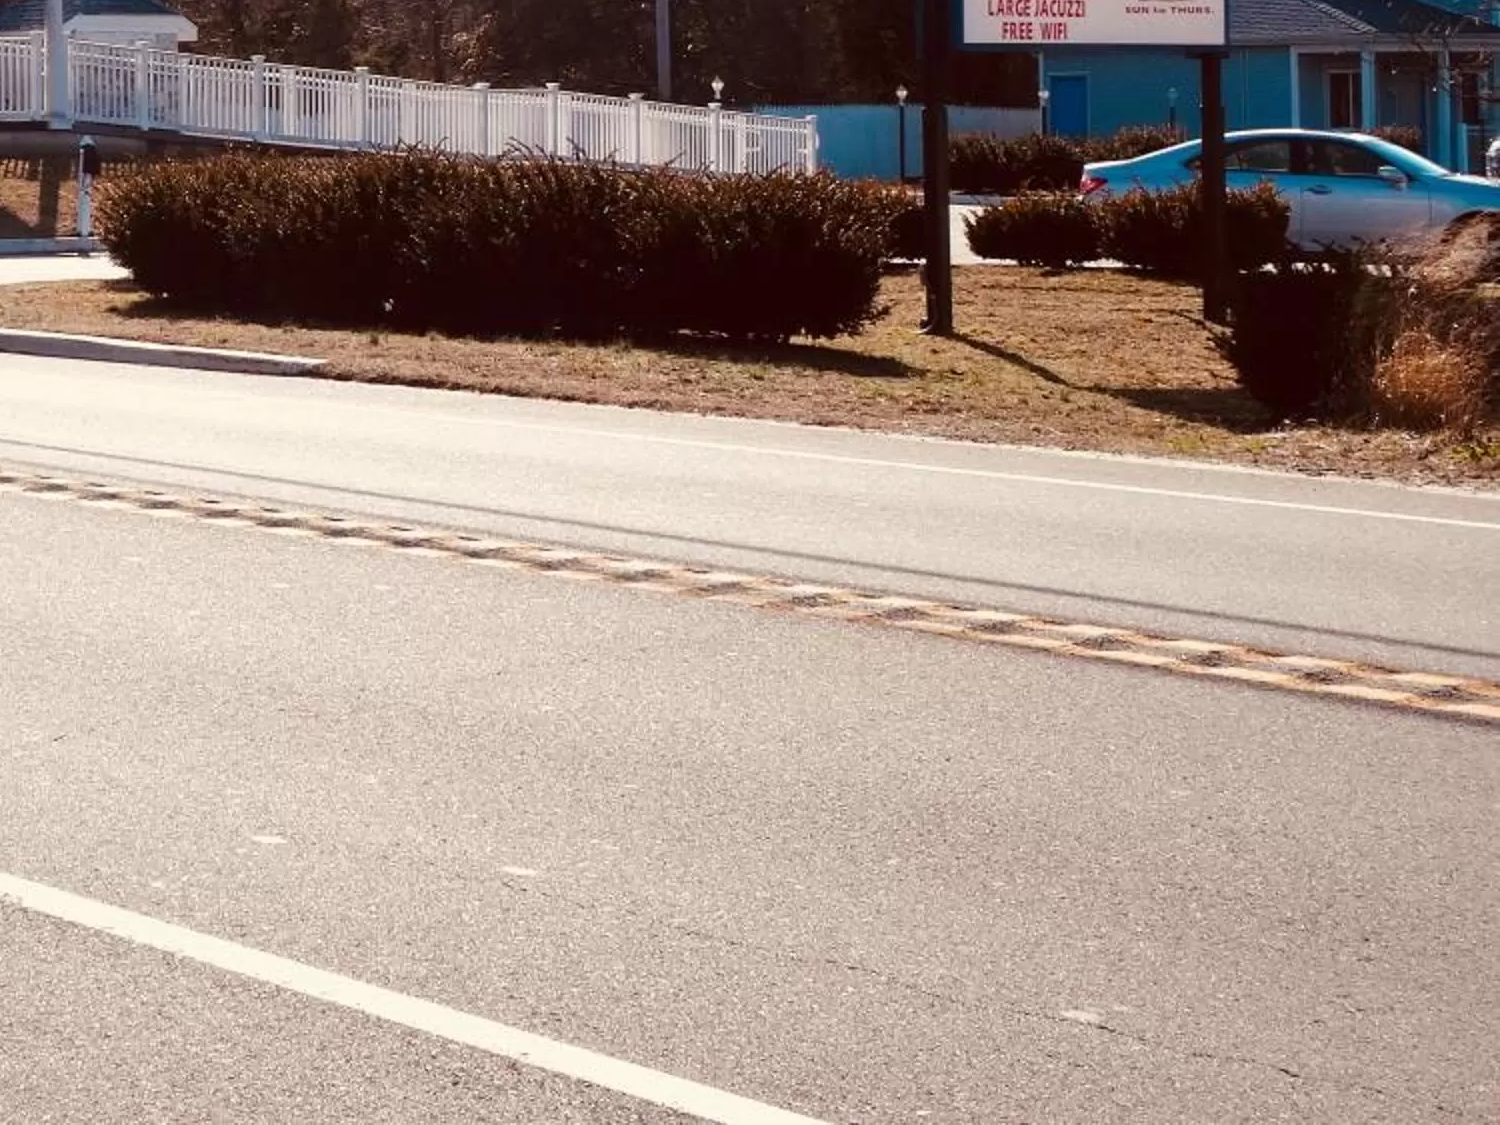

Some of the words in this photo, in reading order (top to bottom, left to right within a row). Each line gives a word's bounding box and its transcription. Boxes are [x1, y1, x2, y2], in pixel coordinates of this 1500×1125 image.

[1034, 0, 1085, 17] JACUZZI
[1125, 6, 1149, 14] SUN
[1001, 22, 1033, 40] FREE
[1039, 22, 1068, 40] WIFI
